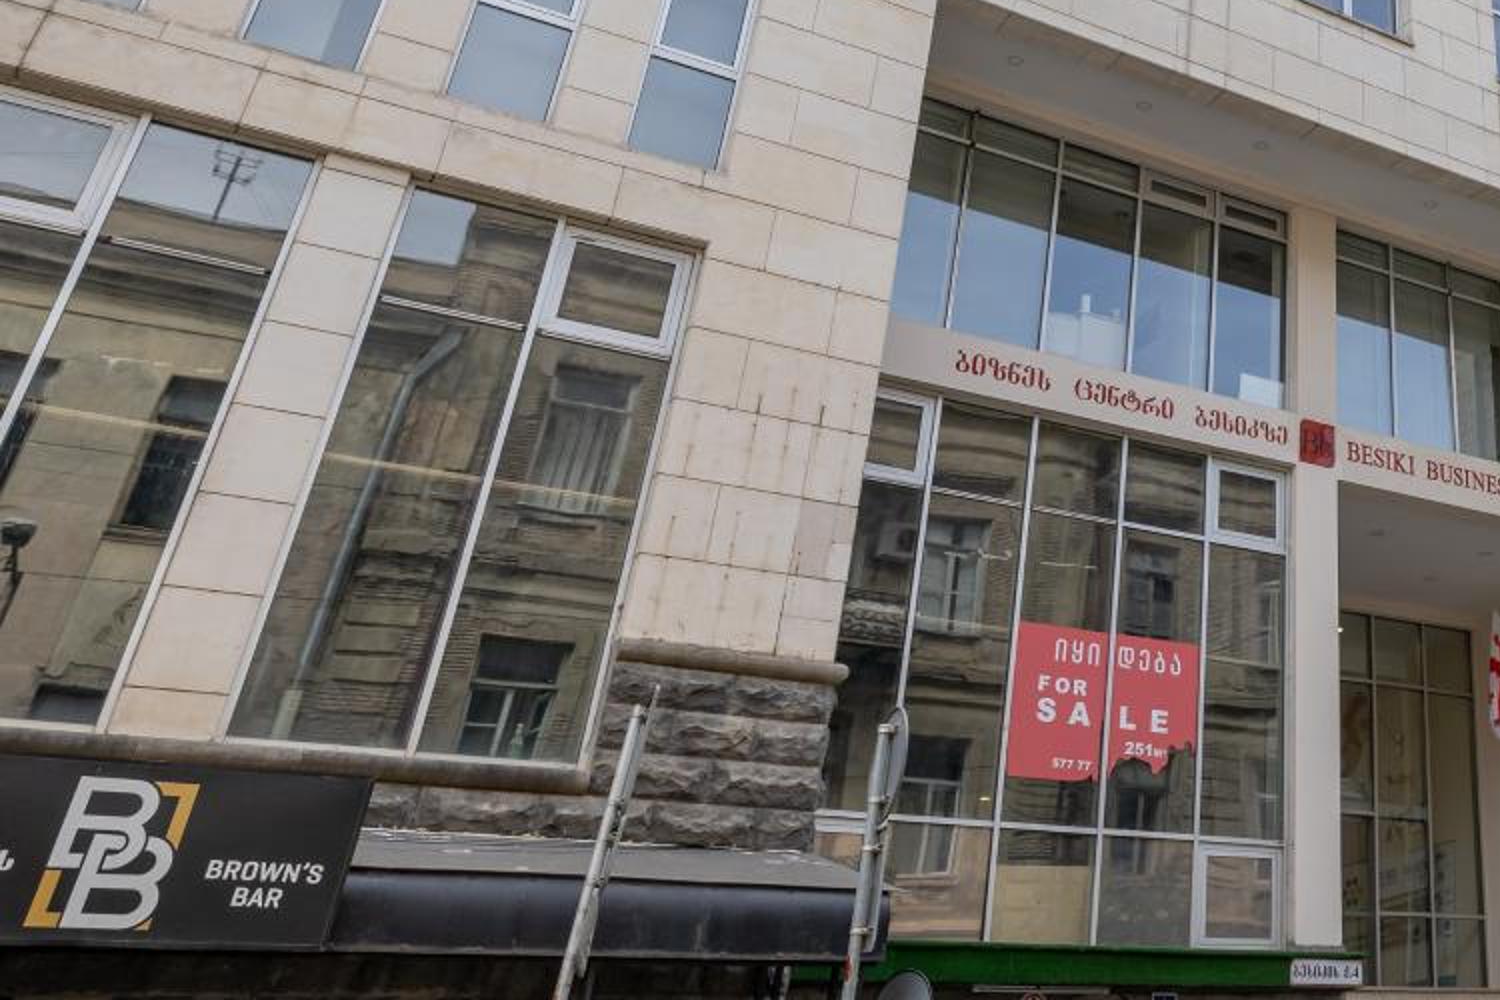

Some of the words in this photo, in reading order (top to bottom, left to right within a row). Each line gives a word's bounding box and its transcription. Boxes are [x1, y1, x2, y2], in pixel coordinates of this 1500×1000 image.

[955, 350, 1051, 392] ბიზნეს
[1074, 377, 1175, 418] ცენტრი
[1347, 441, 1415, 476] BESIKI
[1055, 638, 1182, 676] იყიდება
[1037, 674, 1088, 697] FOR
[1036, 697, 1169, 735] SALE
[204, 859, 325, 885] BROWN'S
[229, 887, 284, 910] BAR
